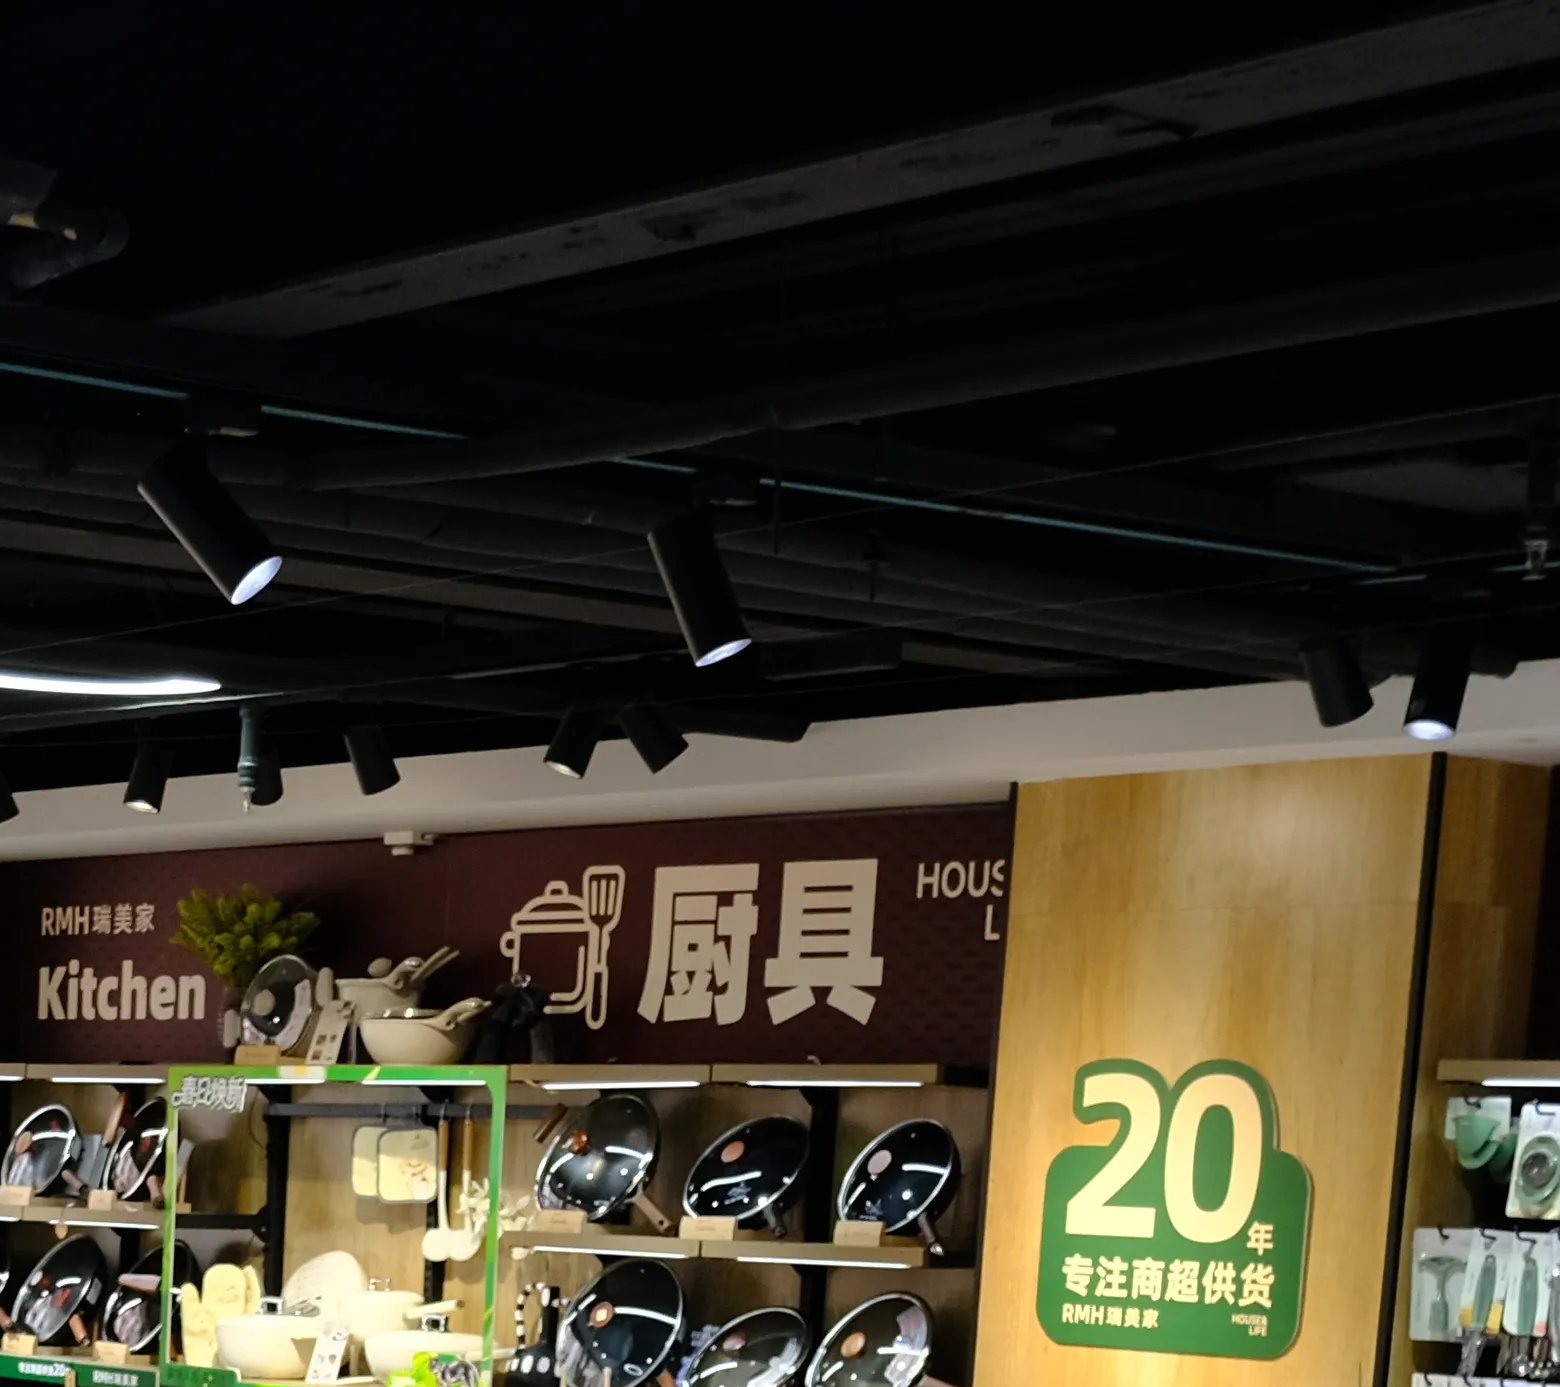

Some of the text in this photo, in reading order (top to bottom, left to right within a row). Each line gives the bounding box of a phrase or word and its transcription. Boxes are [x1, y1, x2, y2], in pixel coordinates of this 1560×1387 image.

[41, 902, 155, 936] RMH瑞美家
[636, 858, 884, 1026] 厨具
[38, 958, 206, 1021] Kitchen
[1065, 1072, 1262, 1243] 20
[1246, 1221, 1274, 1256] 年
[1062, 1253, 1275, 1308] 专注商超供货
[1062, 1303, 1159, 1329] RMH瑞美家
